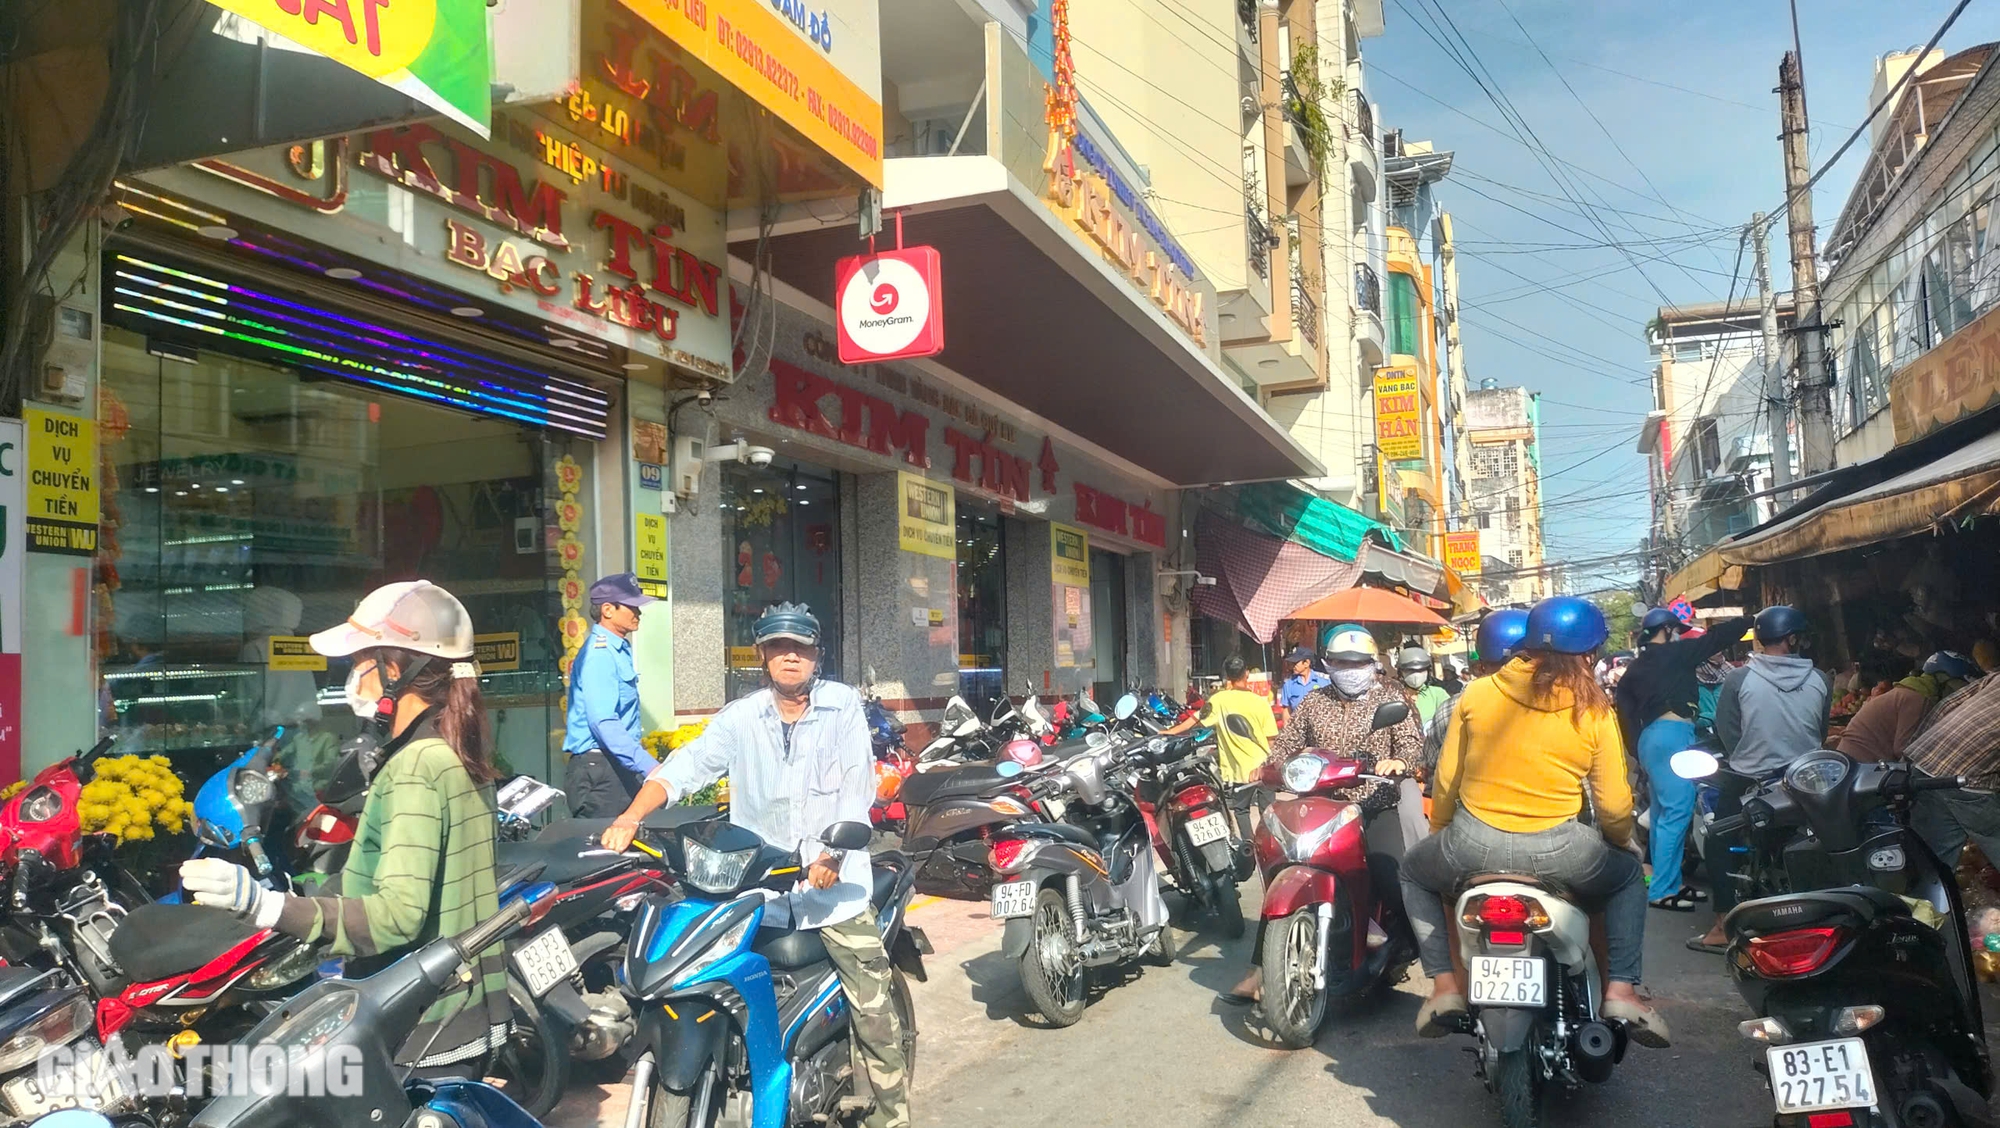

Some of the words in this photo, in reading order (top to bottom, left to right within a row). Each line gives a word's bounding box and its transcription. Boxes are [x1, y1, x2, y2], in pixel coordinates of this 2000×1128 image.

[357, 122, 573, 254] KIM
[446, 218, 562, 296] BẠC
[1379, 394, 1415, 415] KIM
[45, 418, 78, 438] DỊCH
[768, 359, 930, 467] KIM
[944, 427, 1032, 503] TÍN
[1379, 415, 1418, 439] HÂN
[52, 446, 71, 465] VỤ
[32, 468, 90, 491] CHUYỂN
[641, 465, 660, 482] 09
[45, 494, 78, 516] TIỀN
[35, 536, 67, 547] UNION
[1001, 882, 1031, 898] 94-FD
[1772, 905, 1803, 917] YAMAHA
[1481, 959, 1533, 979] 94-FD
[1474, 981, 1541, 1003] 022.62
[1783, 1044, 1850, 1077] 83-E1
[1780, 1073, 1869, 1107] 227.54
